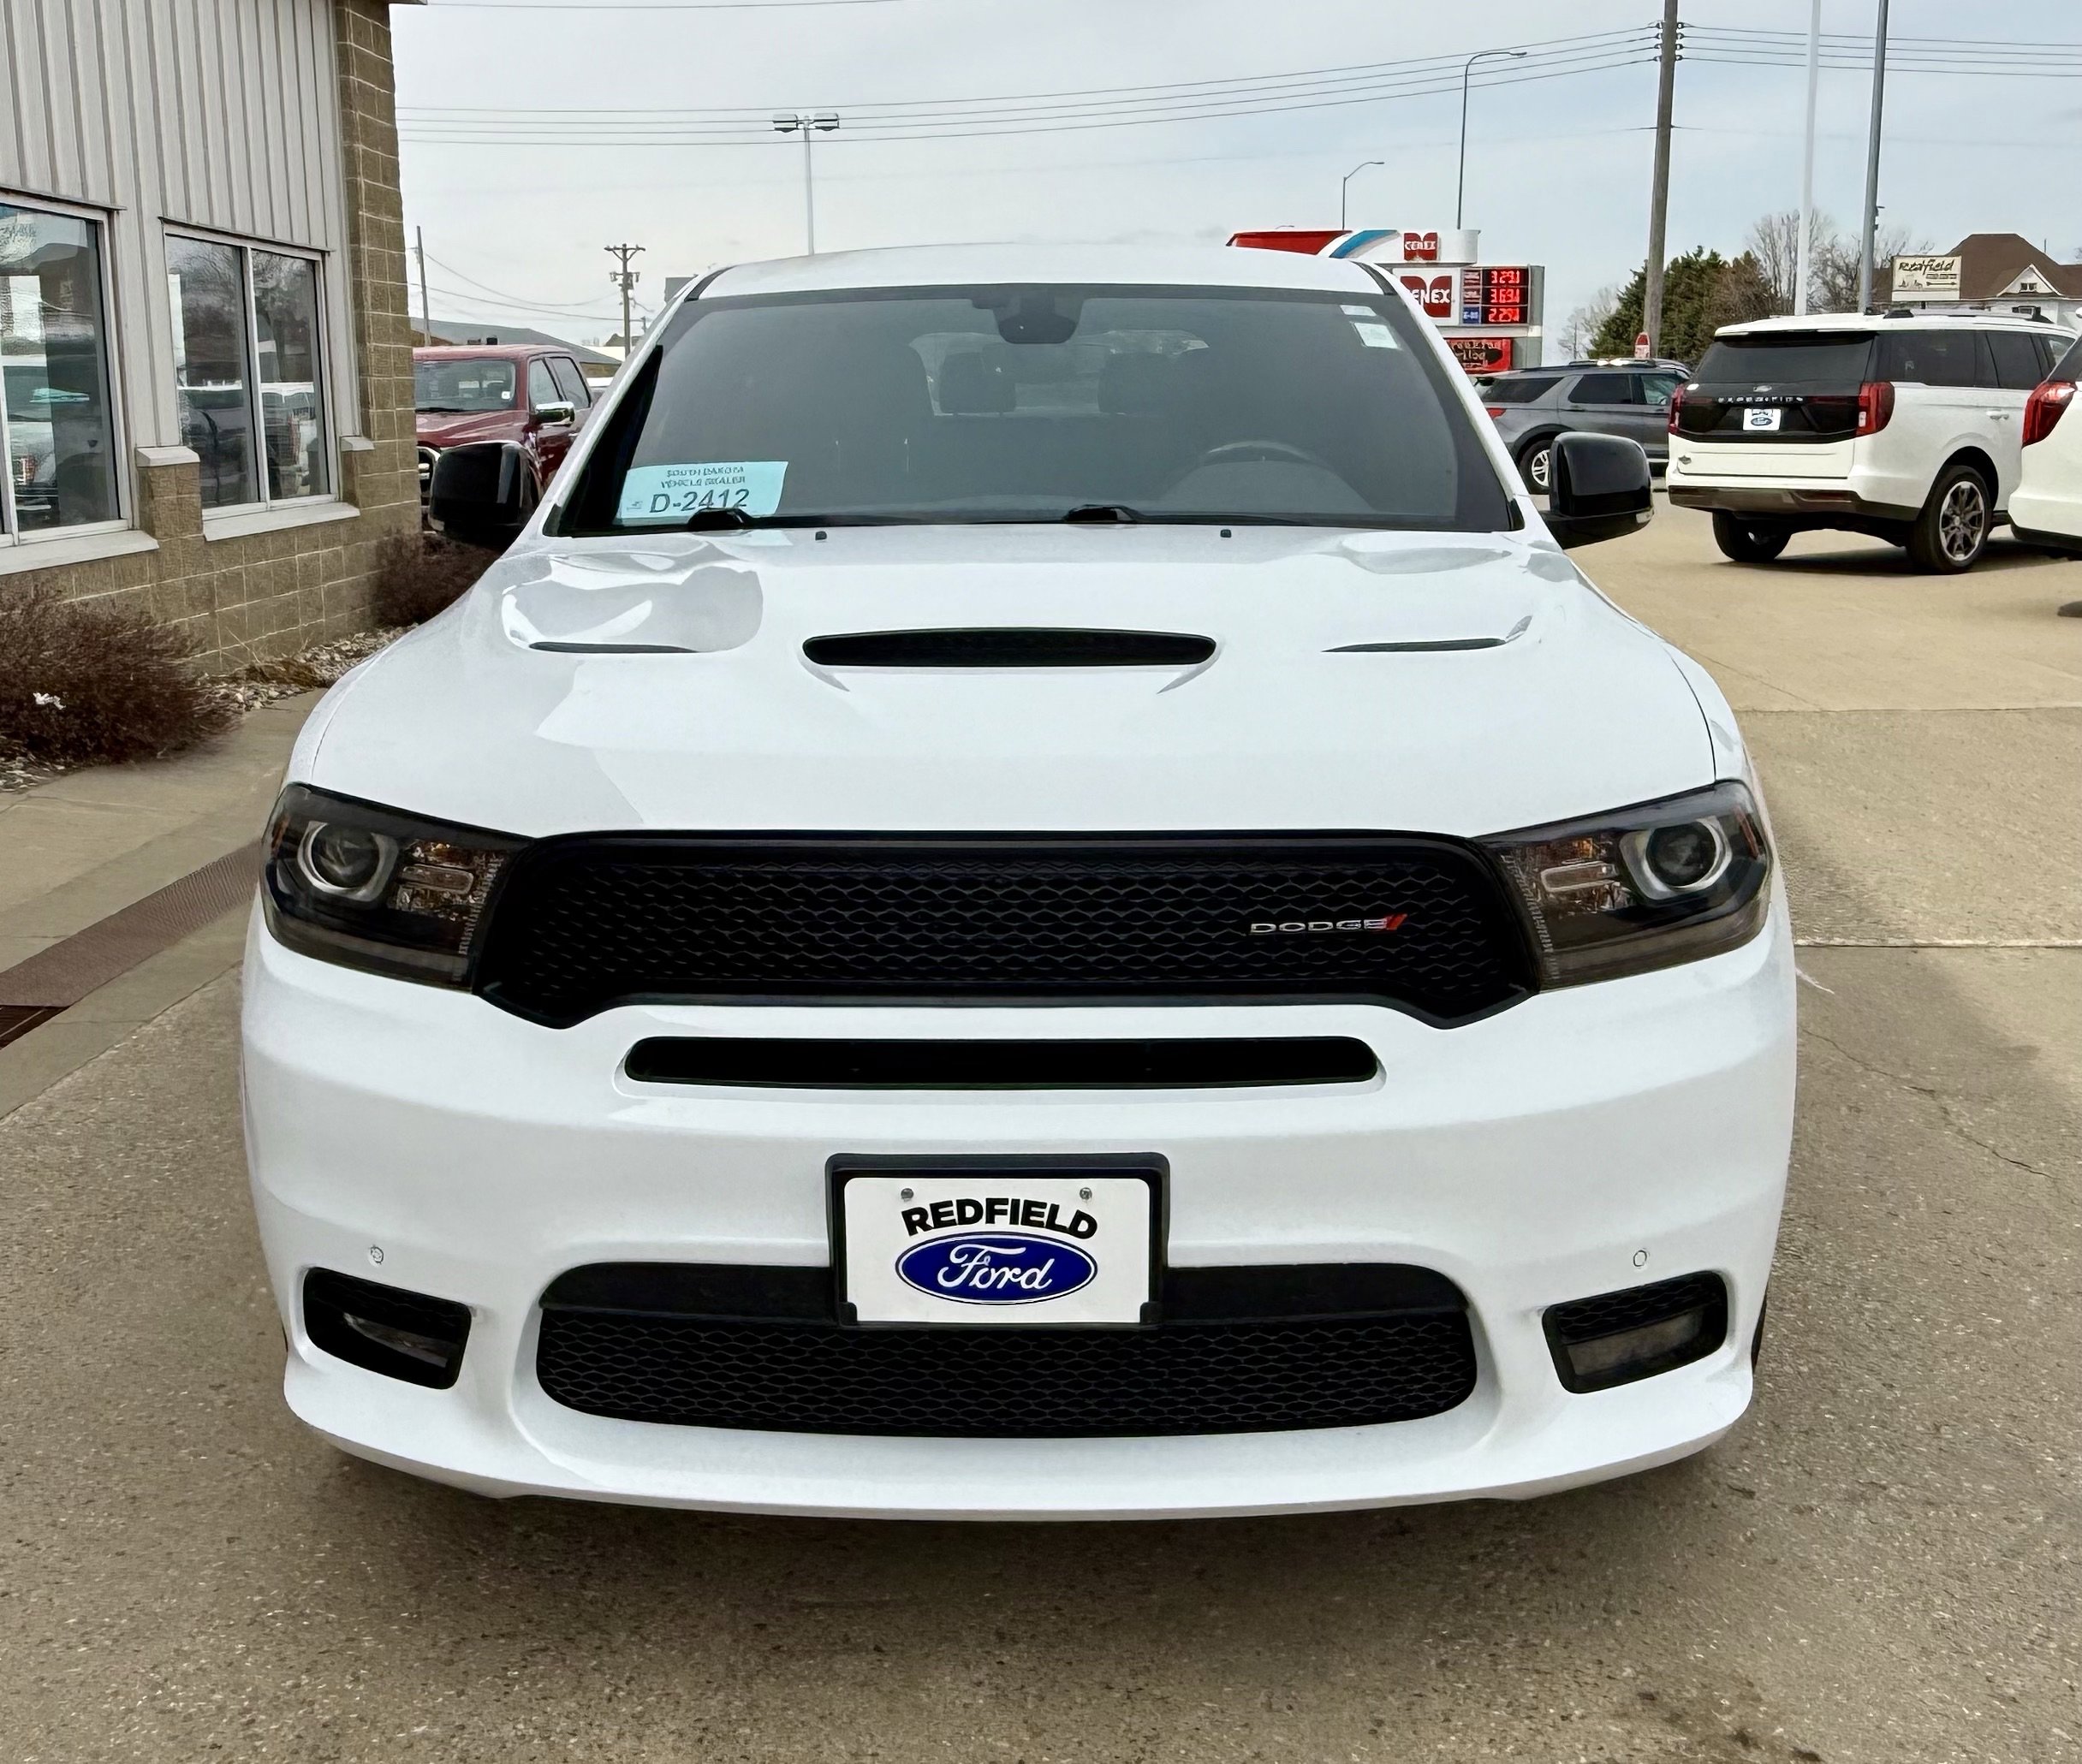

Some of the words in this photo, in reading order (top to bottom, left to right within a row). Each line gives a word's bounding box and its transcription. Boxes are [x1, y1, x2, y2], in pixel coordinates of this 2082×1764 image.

[1411, 288, 1450, 304] ENEX
[649, 488, 750, 513] D-2412
[1250, 918, 1388, 934] DODGE
[901, 1197, 1098, 1239] REDFIELD
[937, 1244, 1056, 1291] Ford
